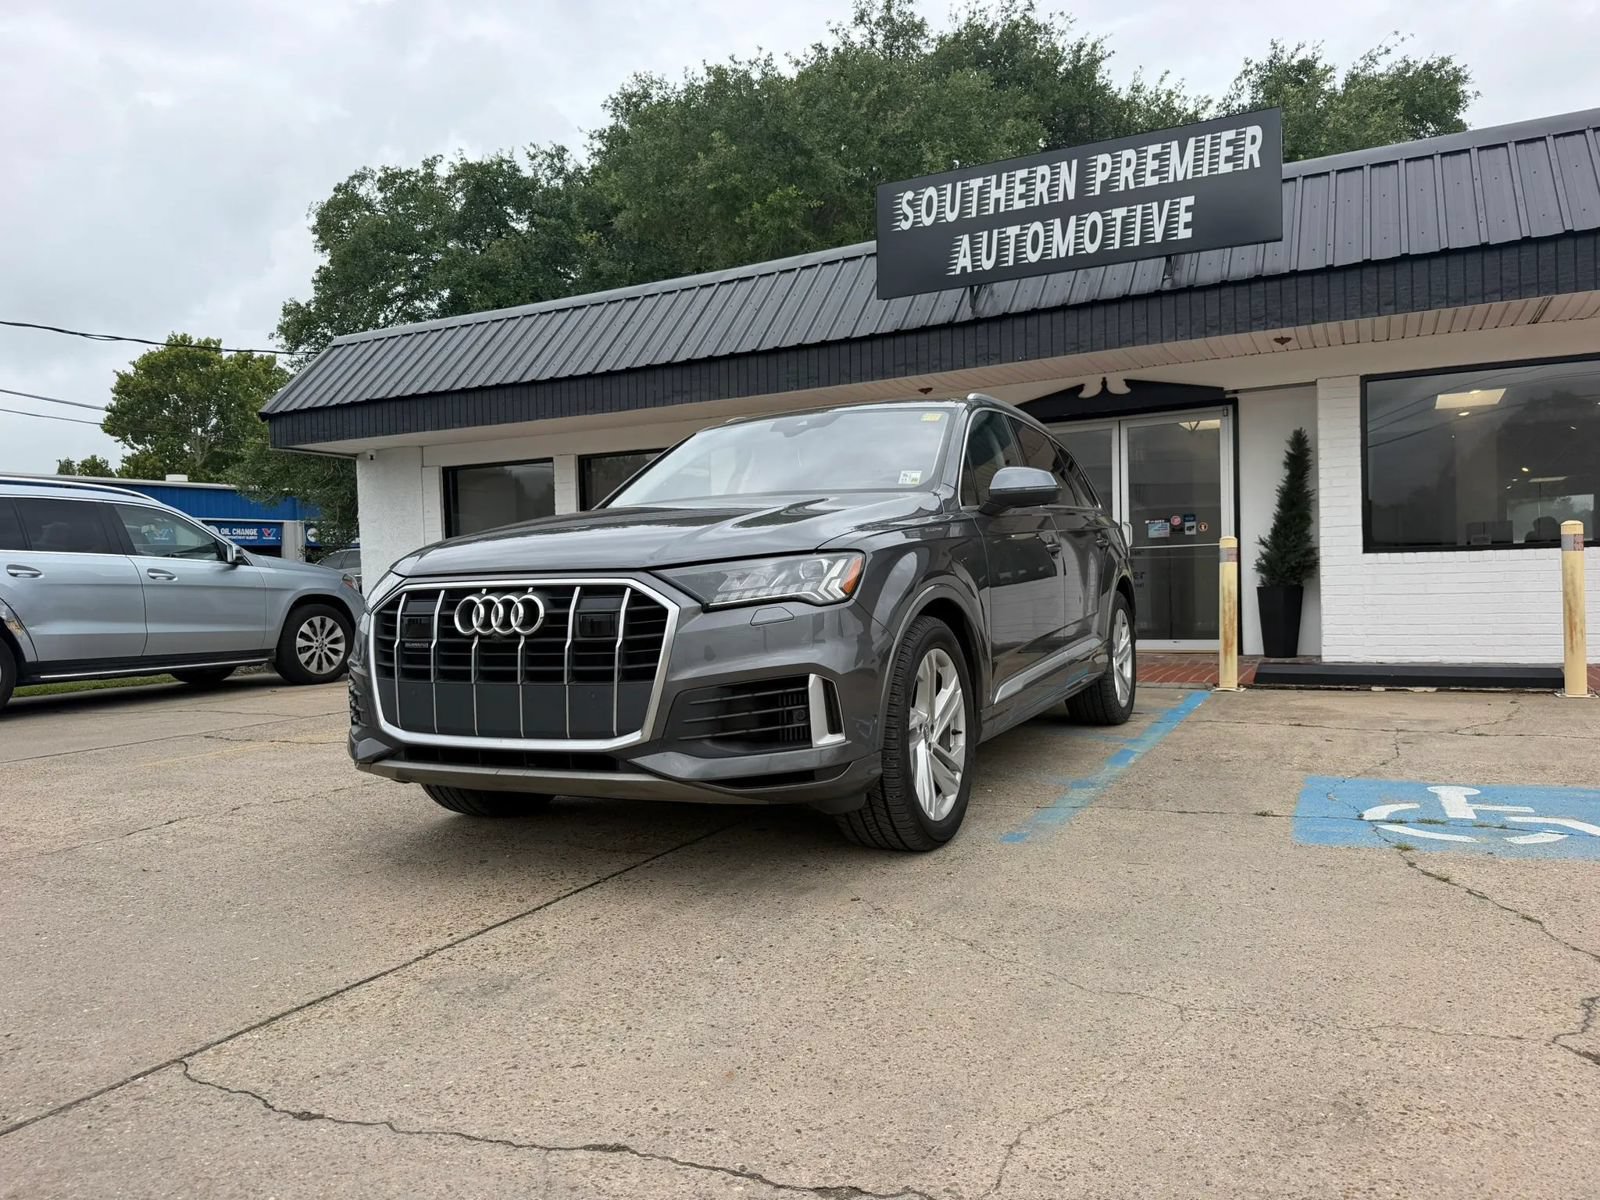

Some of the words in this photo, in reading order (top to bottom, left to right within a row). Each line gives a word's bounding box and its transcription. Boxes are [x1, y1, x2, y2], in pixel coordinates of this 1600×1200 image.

[892, 159, 1078, 231] SOUTHERN
[1084, 125, 1262, 197] PREMIER
[945, 196, 1195, 276] AUTOMOTIVE
[220, 527, 231, 535] OIL
[231, 527, 258, 536] CHANGE
